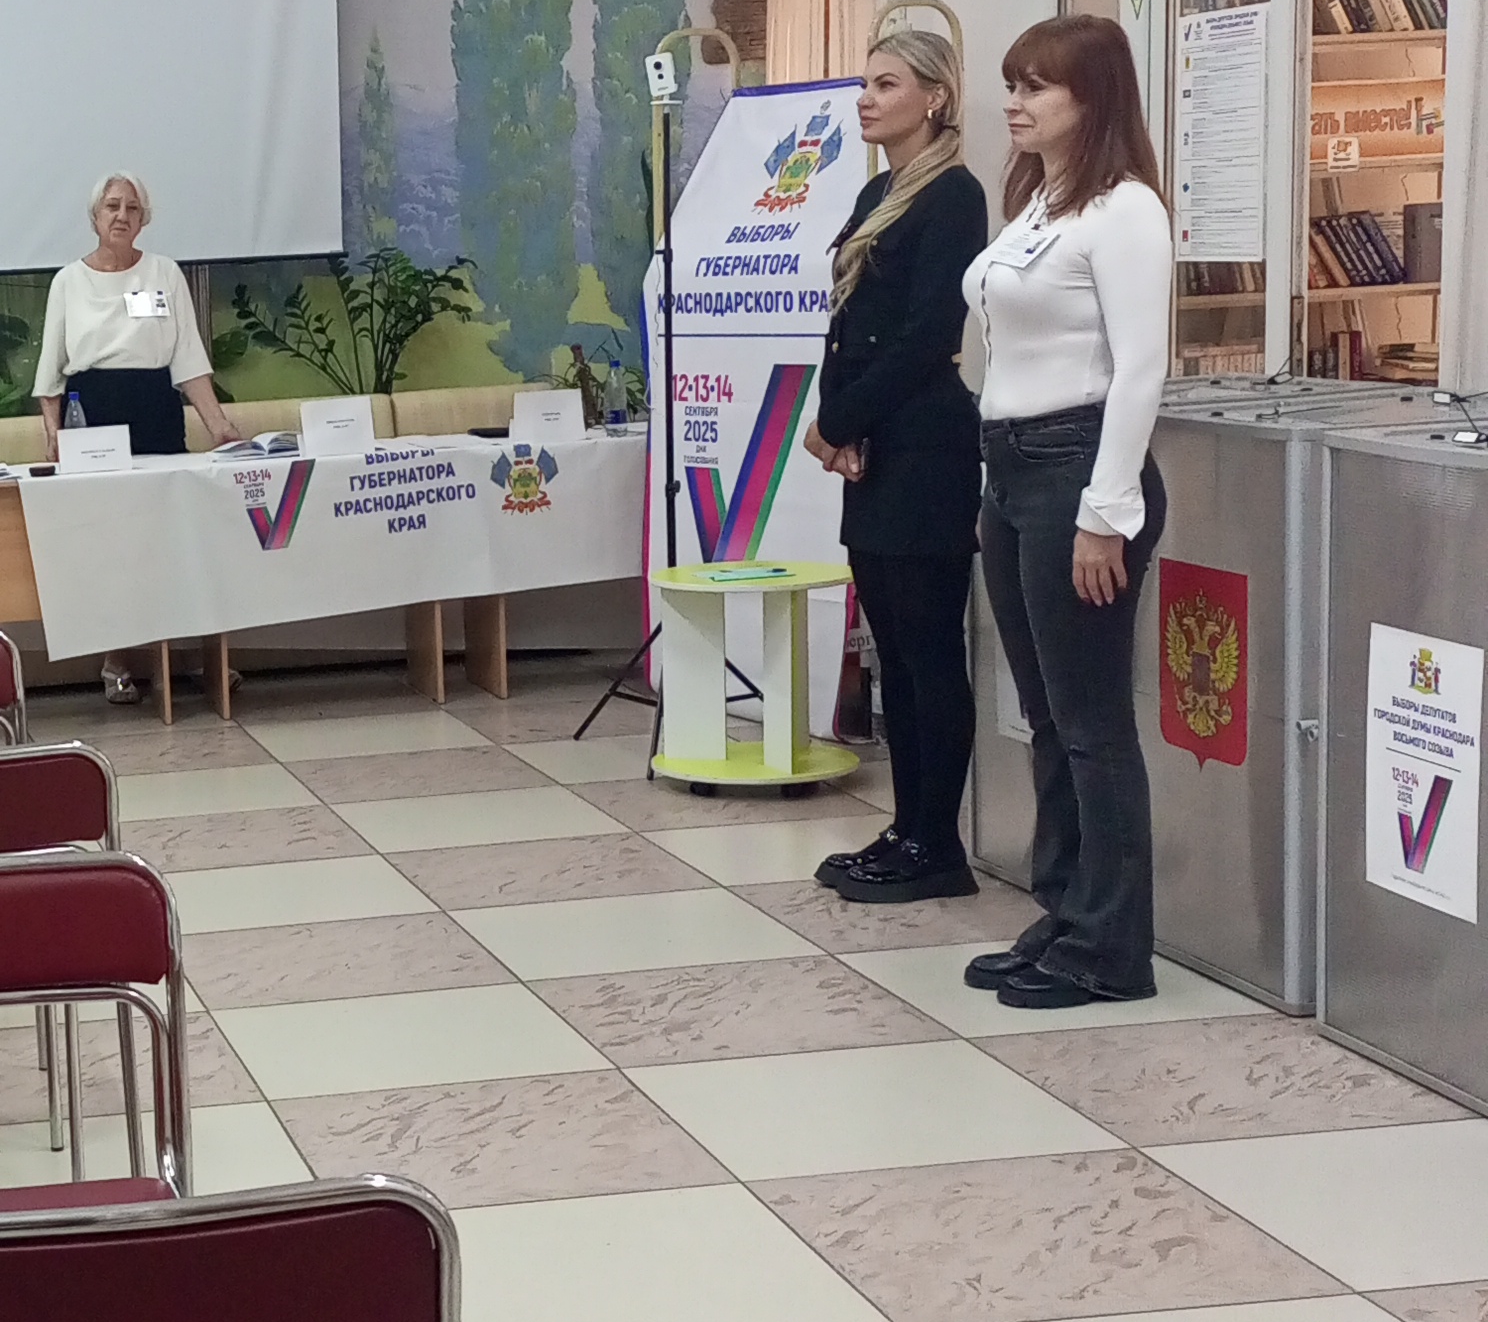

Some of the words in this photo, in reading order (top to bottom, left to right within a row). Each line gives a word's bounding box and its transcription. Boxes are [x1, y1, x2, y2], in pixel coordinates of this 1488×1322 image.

[1310, 111, 1340, 136] ать
[724, 222, 801, 244] ВЫБОРЫ
[695, 253, 801, 277] ГУБЕРНАТОРА
[798, 289, 829, 313] КРА
[684, 405, 719, 417] СЕНТЯБРЯ
[683, 419, 718, 443] 2025
[349, 461, 456, 492] ГУБЕРНАТОРА
[244, 488, 266, 500] 2025
[333, 483, 477, 518] КРАСНОДАРСКОГО
[387, 513, 427, 534] КРАЯ
[1392, 695, 1420, 713] ВЫБОРЫ
[1420, 704, 1457, 724] ДЕПУТАТОВ
[1373, 707, 1410, 728] ГОРОДСКОЙ
[1410, 718, 1432, 735] ДУМЫ
[1432, 725, 1475, 747] КРАСНОДАРА
[1393, 730, 1427, 750] ВОСЬМОГО
[1427, 740, 1454, 758] СОЗЫВА
